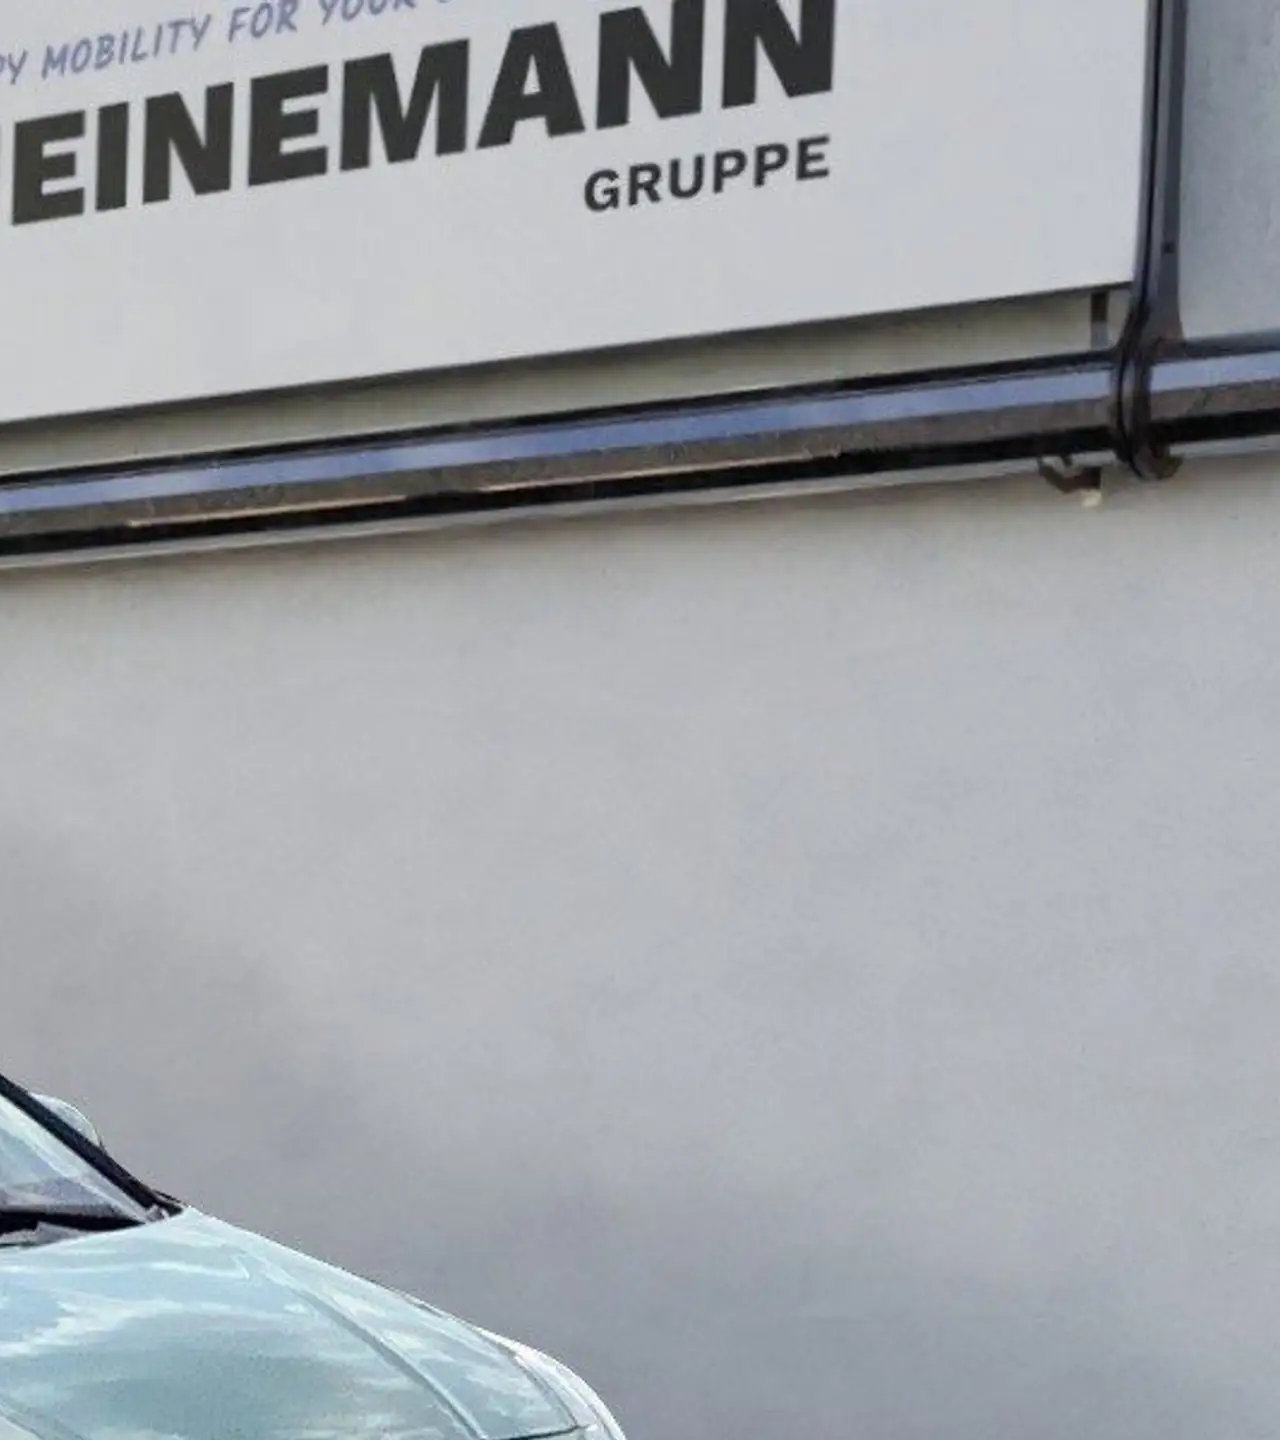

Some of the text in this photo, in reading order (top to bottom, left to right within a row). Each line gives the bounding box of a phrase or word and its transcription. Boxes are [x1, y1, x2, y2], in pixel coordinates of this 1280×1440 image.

[40, 13, 213, 81] MOBILITY
[227, 0, 299, 43] FOR
[317, 0, 418, 27] YO
[583, 134, 831, 213] GRUPPE
